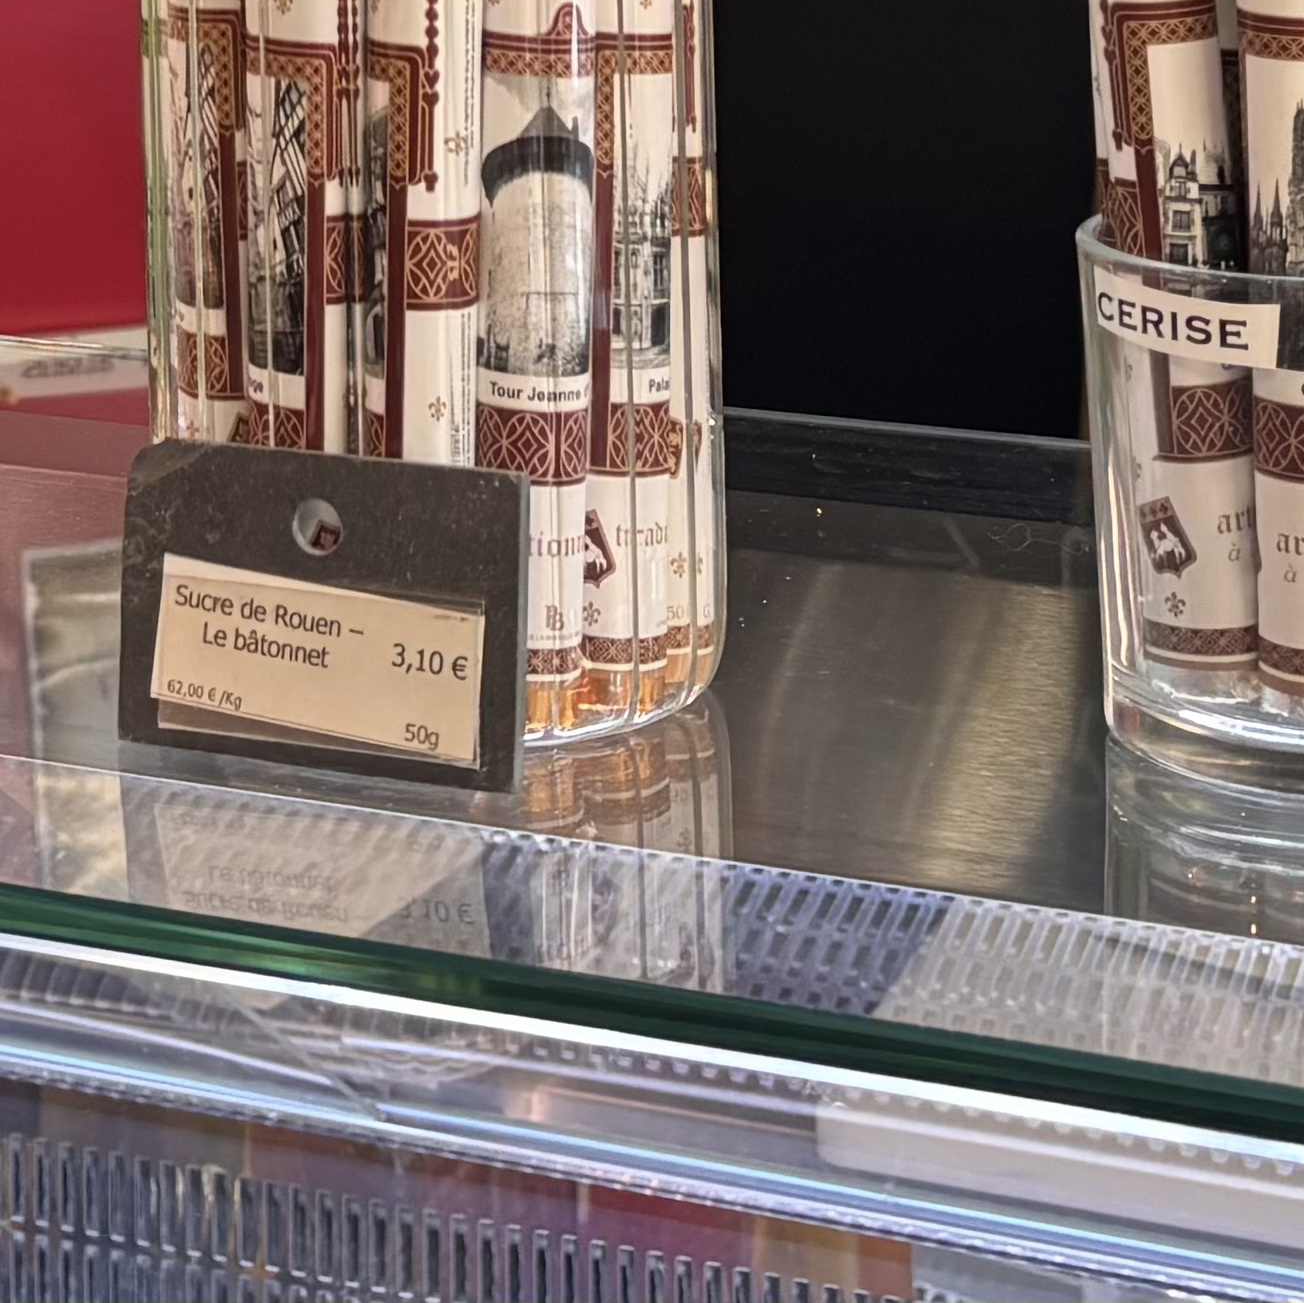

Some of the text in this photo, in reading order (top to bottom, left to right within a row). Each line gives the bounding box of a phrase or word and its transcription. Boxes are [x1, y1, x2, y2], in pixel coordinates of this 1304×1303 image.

[1097, 292, 1250, 351] CERISE
[490, 380, 523, 400] Tour
[1283, 563, 1298, 584] à
[174, 584, 234, 617] Sucre
[240, 597, 267, 623] de
[275, 605, 342, 638] Rouen
[203, 621, 330, 669] Le bâtonnet
[390, 642, 469, 681] 3,10 €
[167, 678, 243, 711] 62,00 € /Kg
[404, 723, 441, 751] 50g
